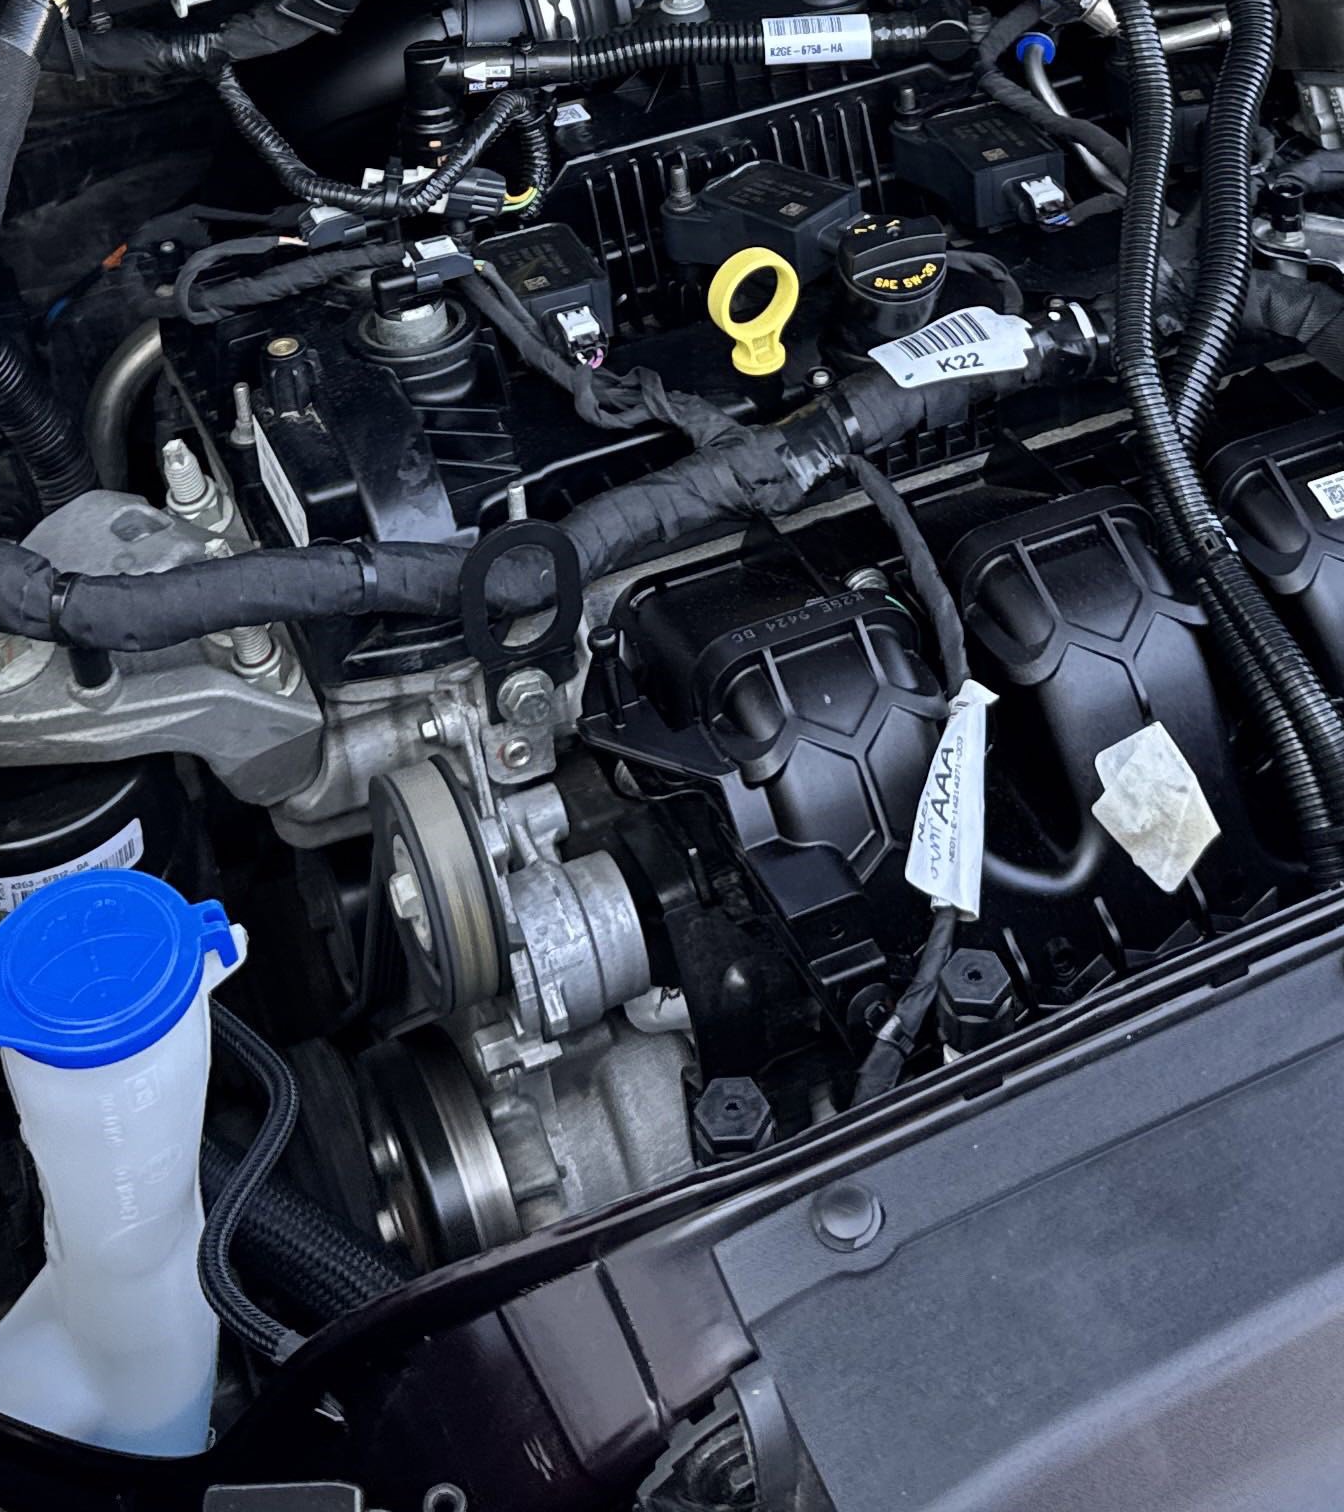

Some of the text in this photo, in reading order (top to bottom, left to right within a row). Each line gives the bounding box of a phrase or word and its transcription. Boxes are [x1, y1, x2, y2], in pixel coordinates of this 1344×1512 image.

[874, 263, 937, 290] SAE 5W-30
[936, 352, 984, 373] K22
[931, 747, 954, 825] AAA
